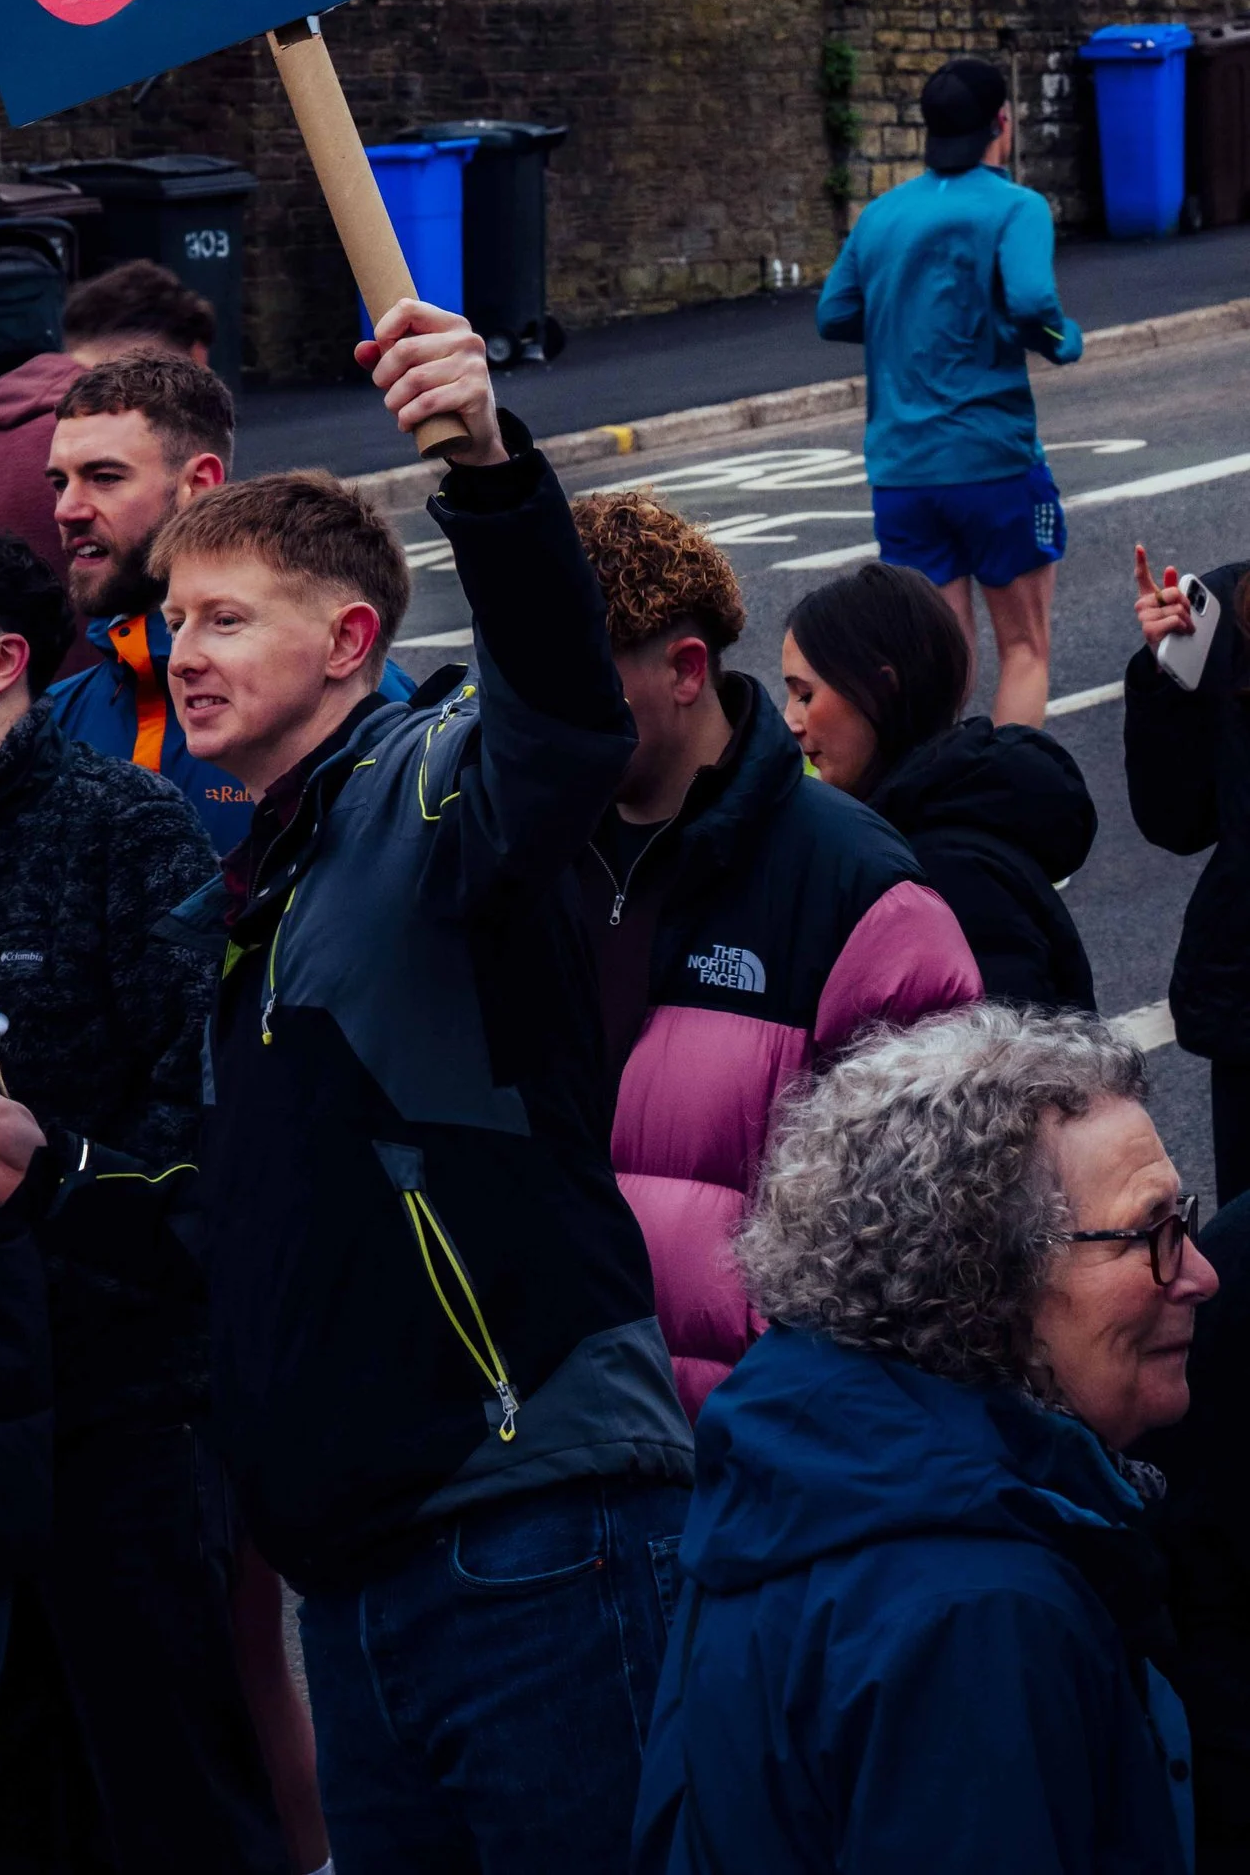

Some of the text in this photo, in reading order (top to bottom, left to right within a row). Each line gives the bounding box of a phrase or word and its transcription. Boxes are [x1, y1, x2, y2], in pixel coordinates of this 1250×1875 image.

[6, 952, 44, 961] Columbia
[712, 944, 742, 961] THE
[688, 955, 739, 975] NORTH
[700, 970, 738, 988] FACE
